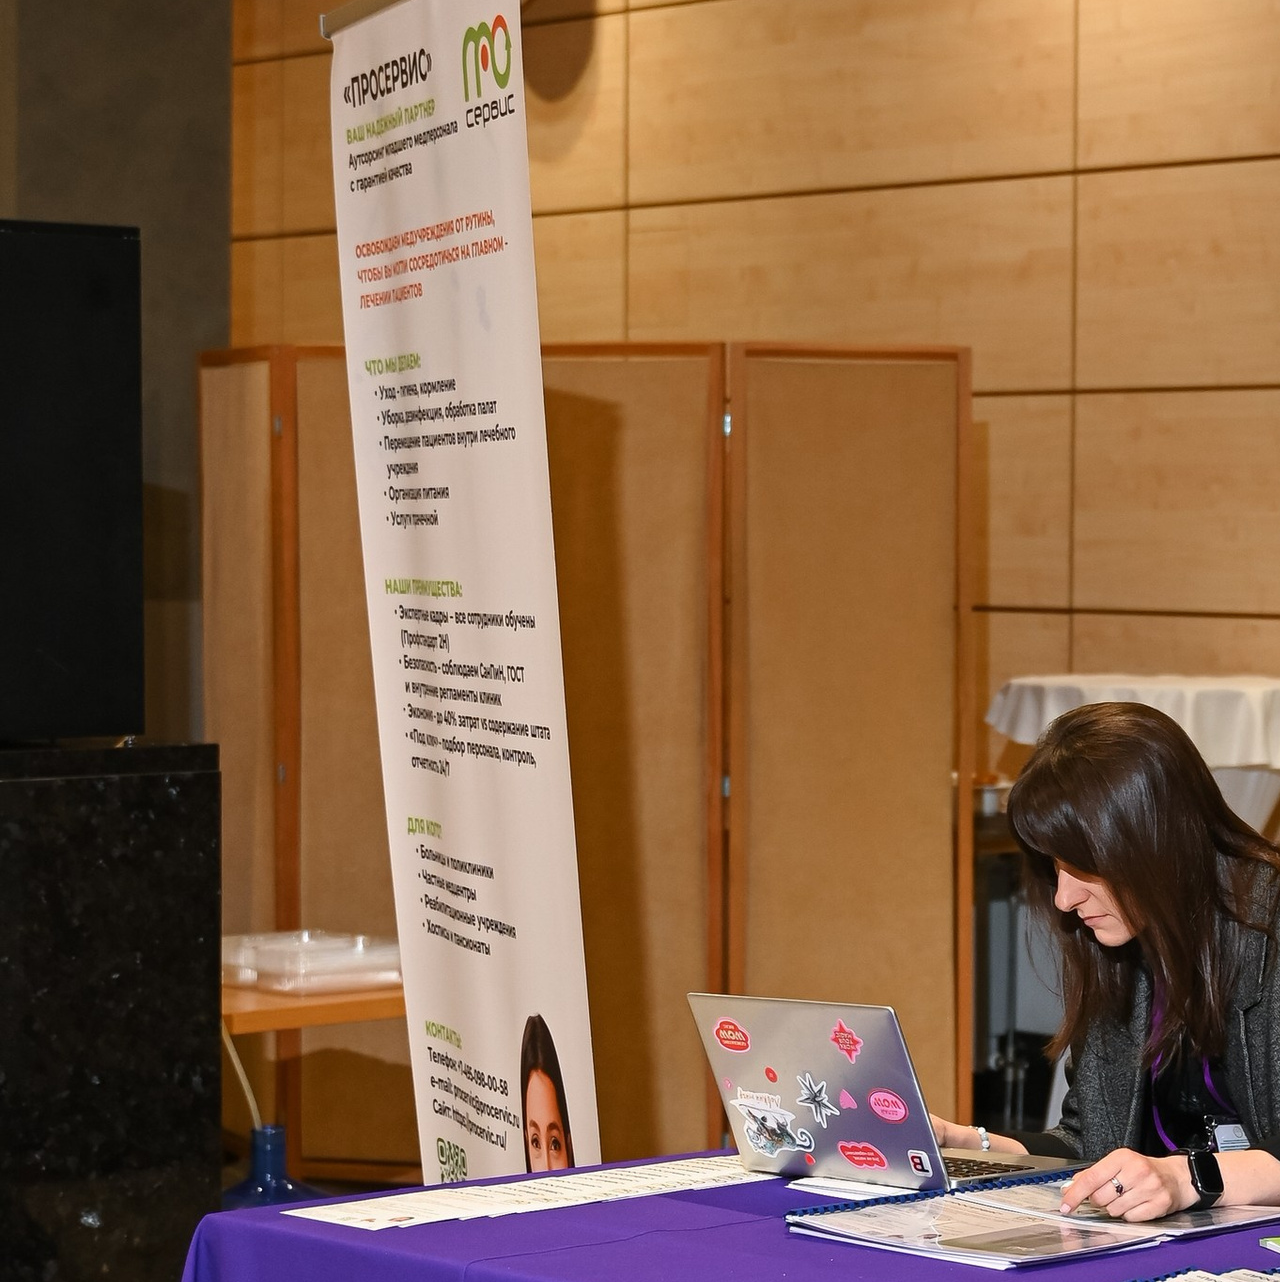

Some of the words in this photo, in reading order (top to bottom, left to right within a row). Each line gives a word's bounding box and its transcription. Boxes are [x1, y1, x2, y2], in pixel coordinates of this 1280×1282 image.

[343, 48, 432, 107] «ПРОСЕРВИС»
[346, 125, 365, 145] ВАШ
[404, 98, 435, 125] ПАРТНЕР
[465, 93, 515, 128] сервис
[348, 146, 385, 171] Аутсорсинг
[413, 120, 458, 147] медперсонала
[455, 217, 465, 233] ОТ
[465, 210, 496, 231] РУТИНЫ,
[357, 266, 383, 283] ЧТОБЫ
[460, 244, 471, 260] НА
[471, 236, 504, 258] ГЛАВНОМ
[360, 291, 391, 309] ЛЕЧЕНИИ
[364, 358, 384, 376] ЧТО
[379, 385, 397, 402] Уход
[420, 378, 456, 398] кормление
[445, 400, 476, 421] обработка
[477, 400, 497, 416] палат
[421, 432, 456, 450] пациентов
[456, 430, 478, 449] внутри
[479, 424, 516, 442] лечебного
[422, 486, 449, 500] питания
[385, 578, 411, 595] НАШИ
[454, 611, 467, 623] все
[467, 612, 504, 629] сотрудники
[504, 610, 536, 632] обучены
[441, 659, 479, 679] соблюдаем
[506, 665, 525, 683] ГОСТ
[439, 686, 479, 704] регламенты
[479, 691, 503, 707] клиник
[443, 711, 457, 727] 40%
[457, 714, 480, 734] затрат
[480, 717, 488, 731] vs
[488, 718, 529, 738] содержание
[530, 723, 551, 740] штата
[441, 736, 466, 757] подбор
[466, 741, 501, 762] персонала,
[501, 748, 537, 768] контроль,
[407, 816, 424, 835] ДЛЯ
[450, 857, 495, 880] поликлиники
[476, 915, 517, 940] учреждения
[719, 1029, 746, 1041] WOW
[873, 1097, 902, 1110] WOW
